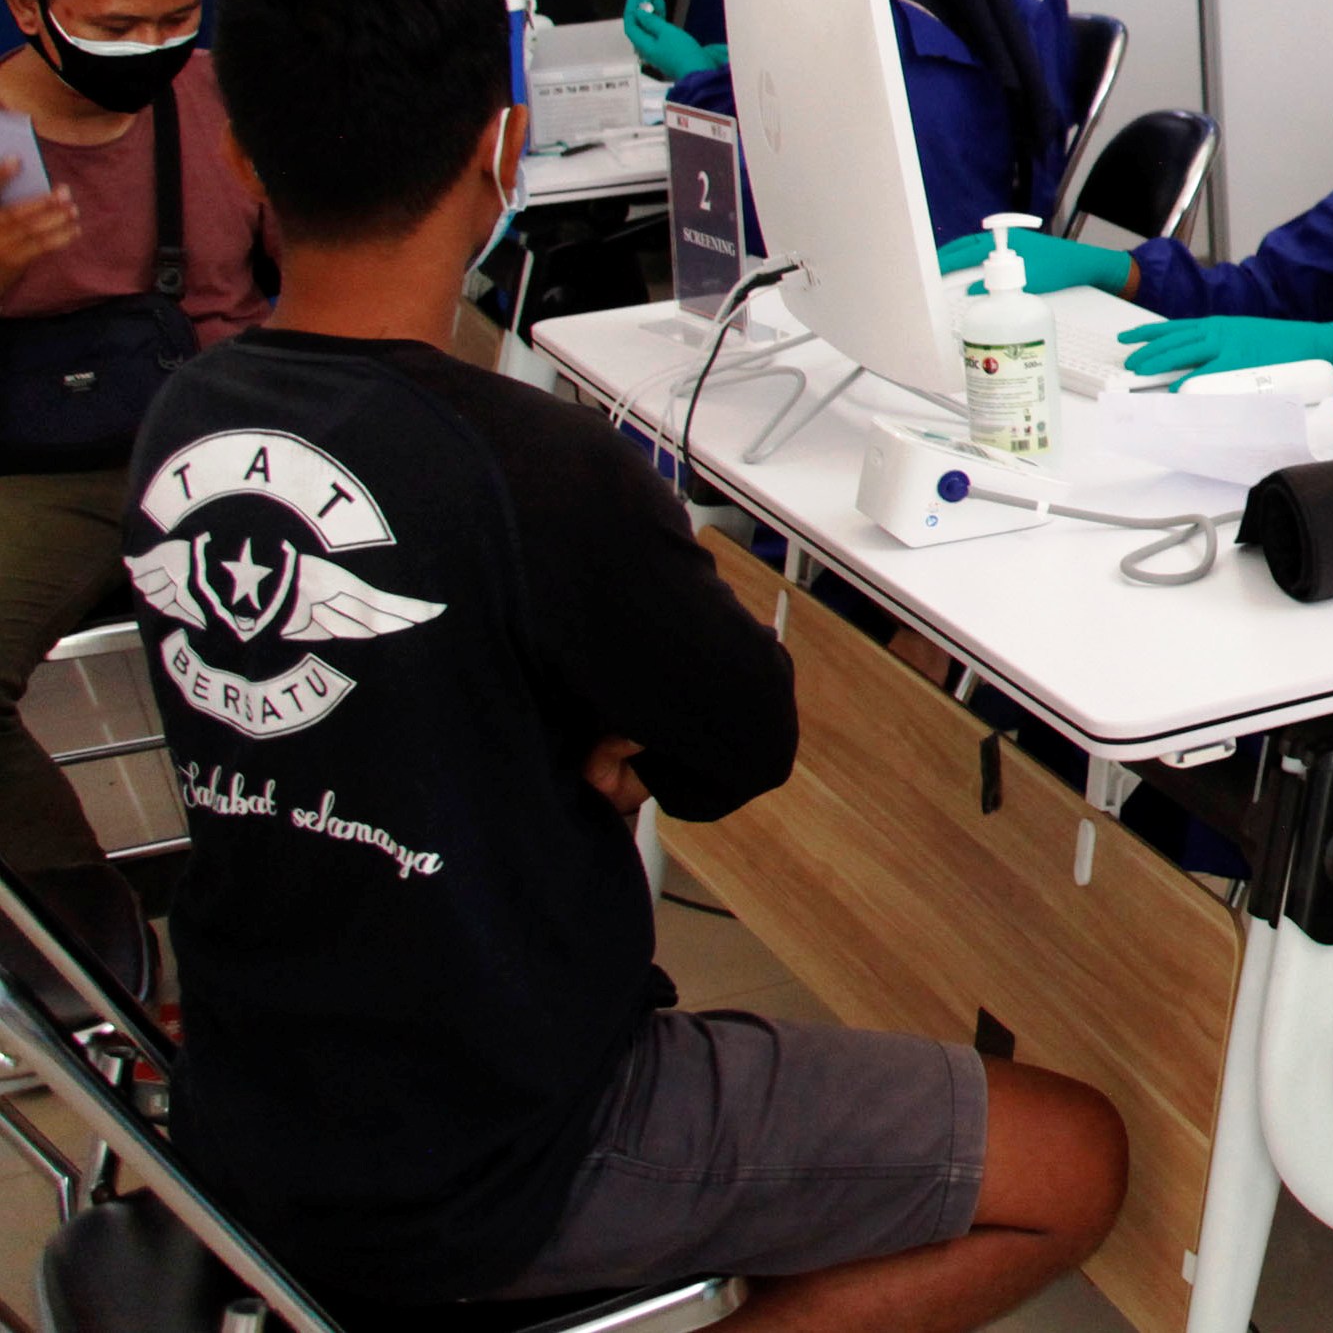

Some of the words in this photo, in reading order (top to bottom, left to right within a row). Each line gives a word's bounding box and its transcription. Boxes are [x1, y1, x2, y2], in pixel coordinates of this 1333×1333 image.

[697, 171, 711, 211] 2
[683, 227, 736, 257] SCREENING
[173, 446, 354, 518] TAT
[173, 647, 328, 724] BERSATU
